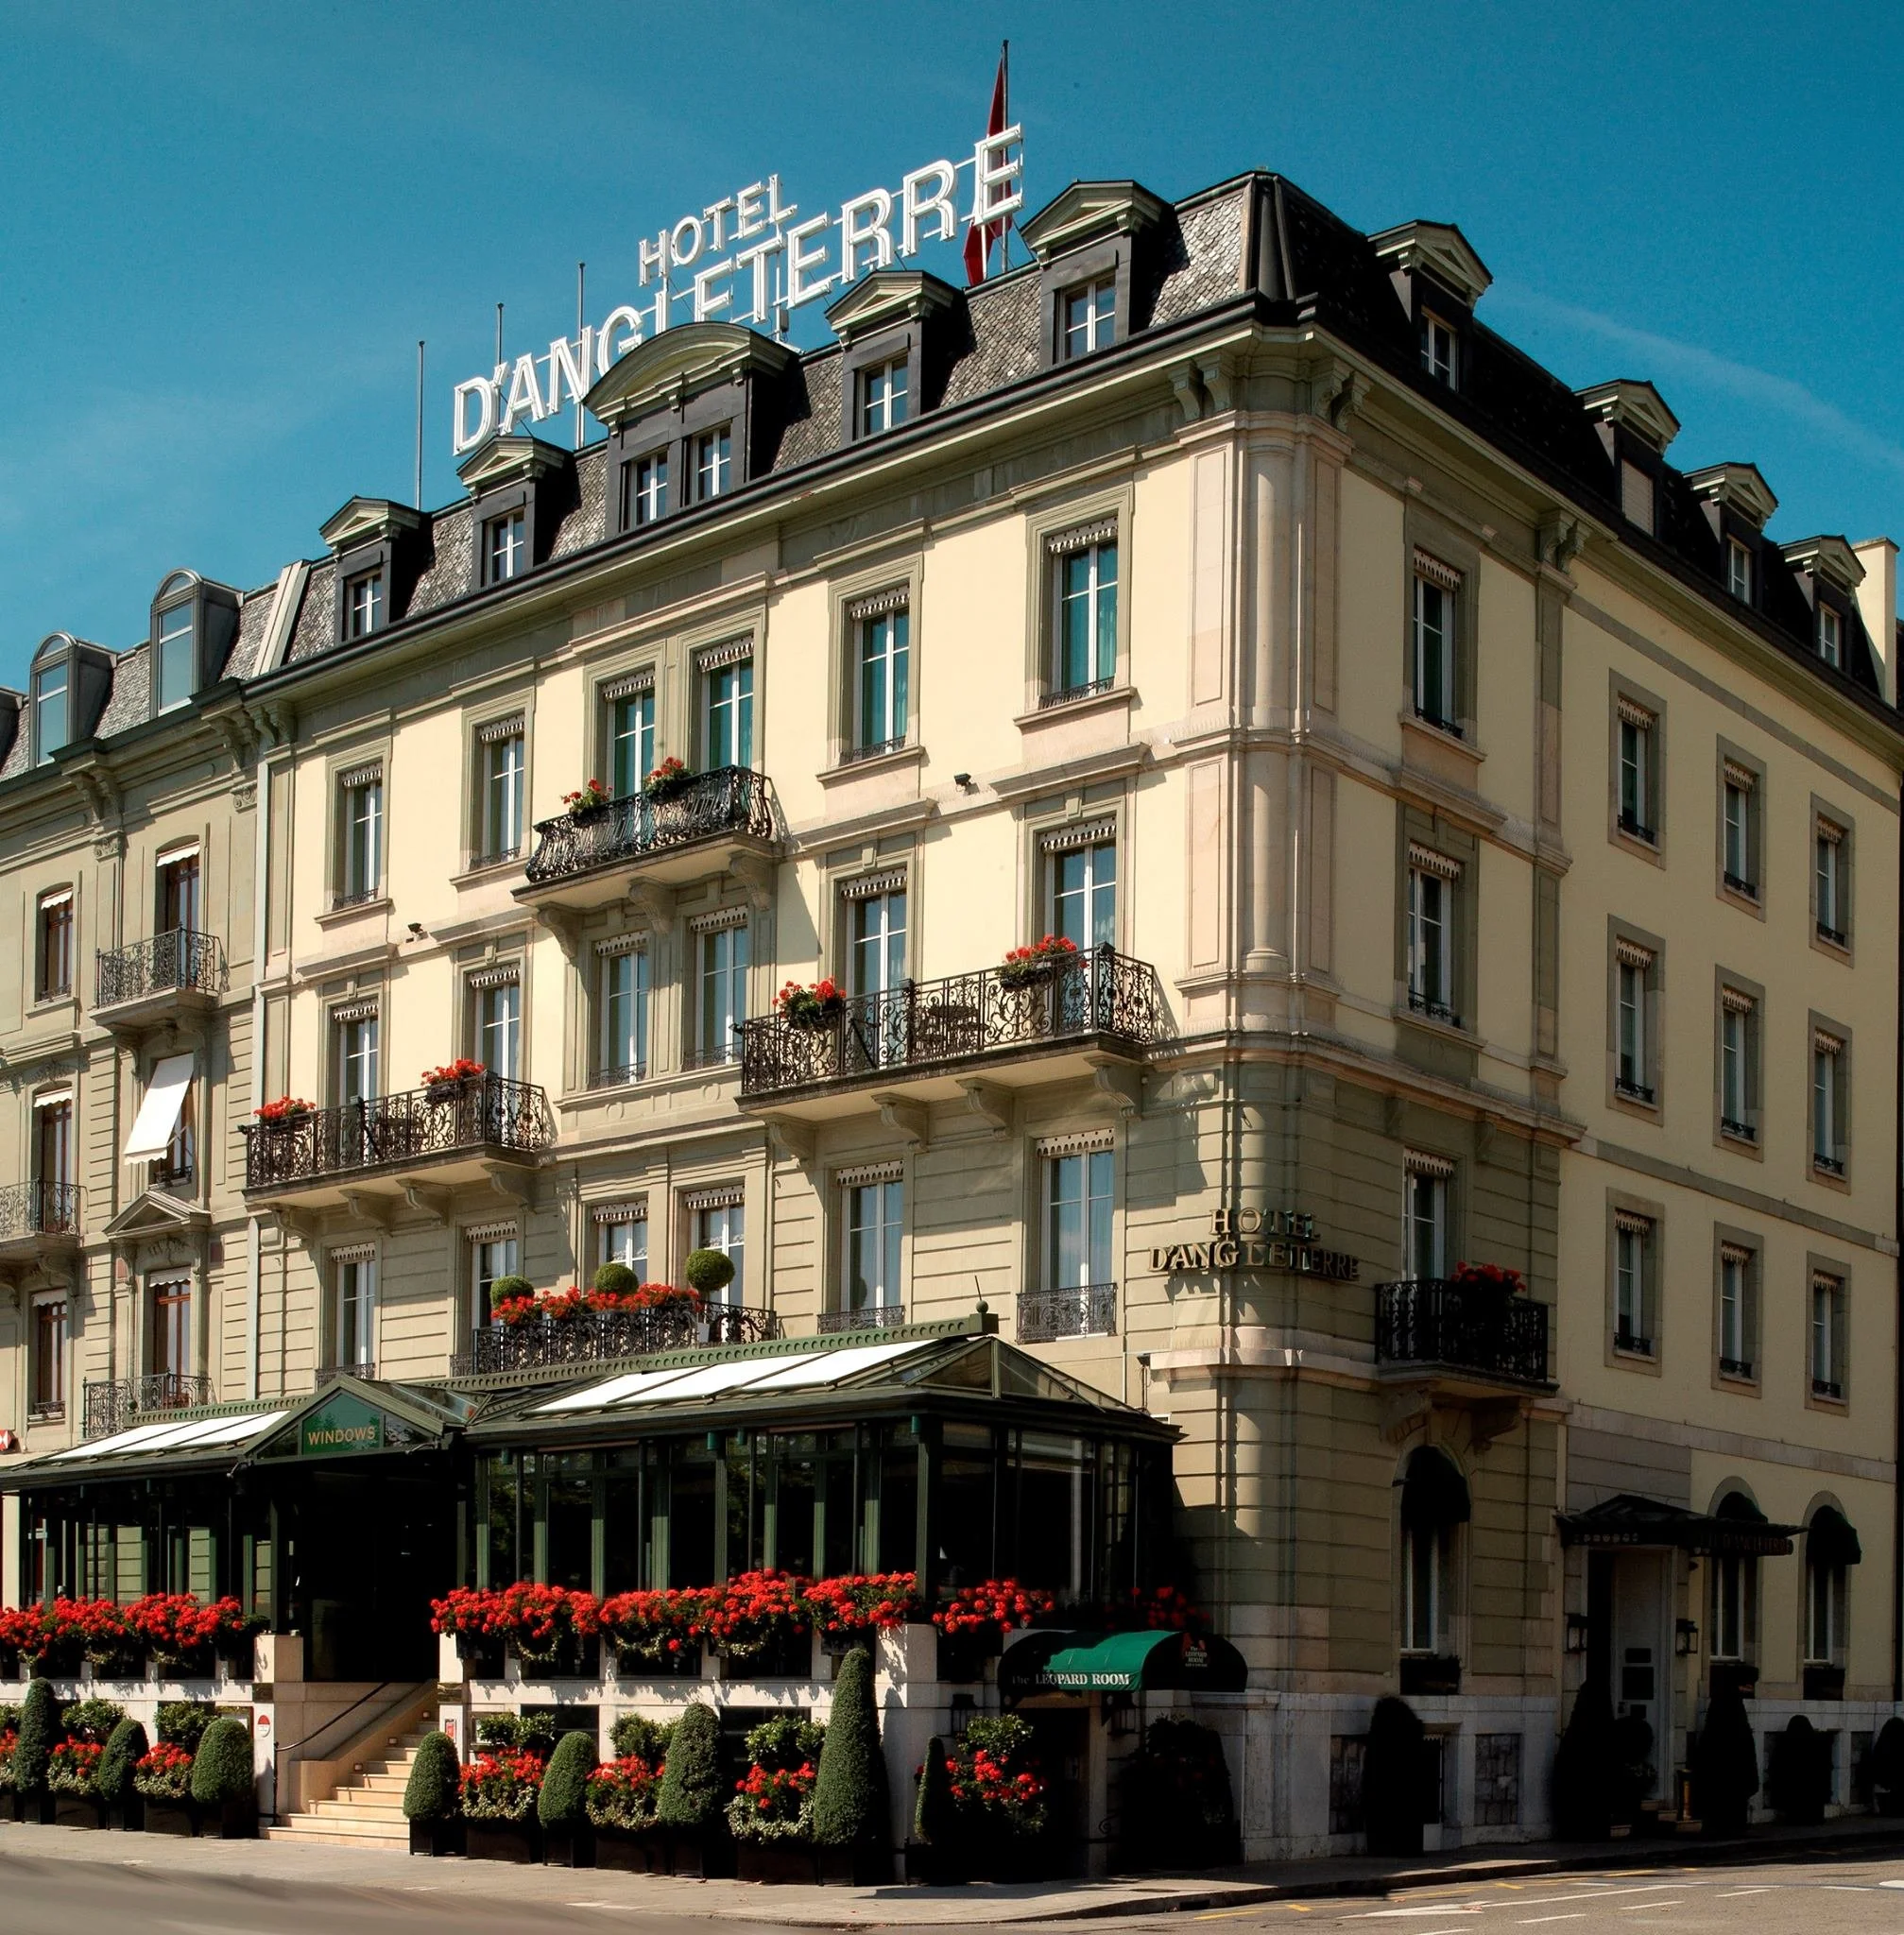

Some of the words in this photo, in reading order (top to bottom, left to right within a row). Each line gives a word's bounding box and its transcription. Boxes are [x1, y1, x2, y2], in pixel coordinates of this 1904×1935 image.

[638, 173, 798, 286] HOTEL
[1209, 1207, 1321, 1241] HOTEL
[1148, 1239, 1362, 1281] D'ANGLETERRE
[308, 1427, 376, 1446] WINDOWS
[1012, 1674, 1030, 1687] The
[1036, 1672, 1088, 1686] LEOPARD
[1092, 1673, 1130, 1686] ROOM
